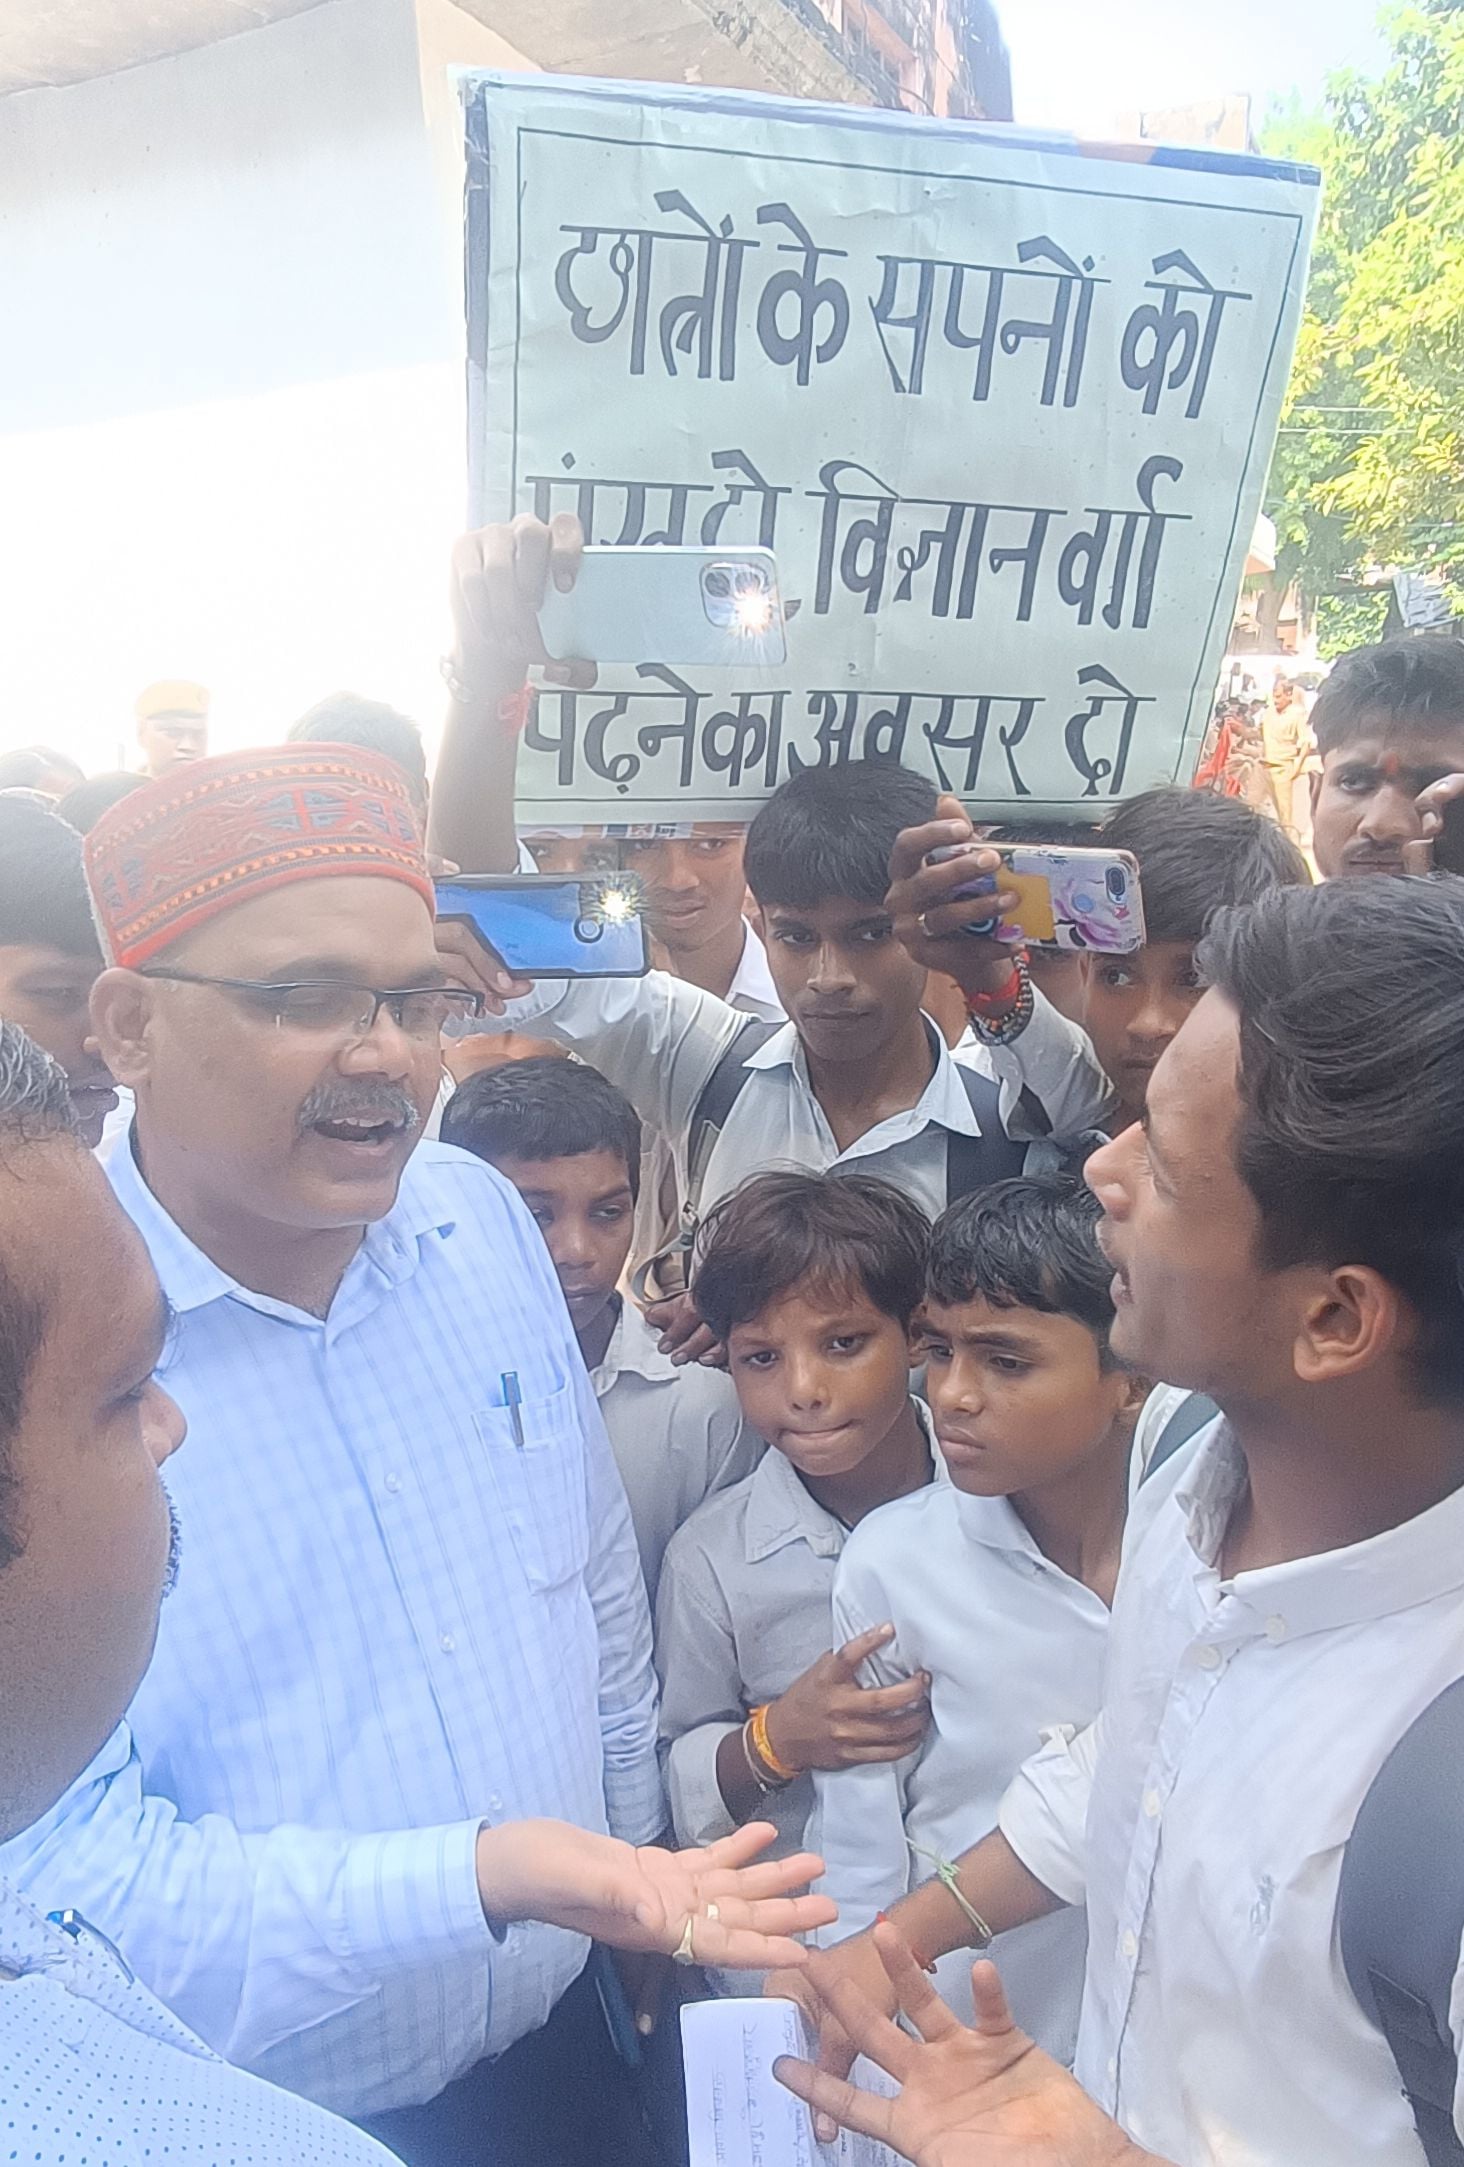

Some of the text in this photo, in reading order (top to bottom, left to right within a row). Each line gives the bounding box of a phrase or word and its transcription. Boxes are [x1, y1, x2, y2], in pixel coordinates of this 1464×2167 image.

[555, 189, 1252, 418] छात्रों के सपनों को
[805, 460, 1067, 621] विज्ञान
[1058, 455, 1192, 630] वर्ग
[525, 662, 1156, 797] पढ़ने का अवसर दो
